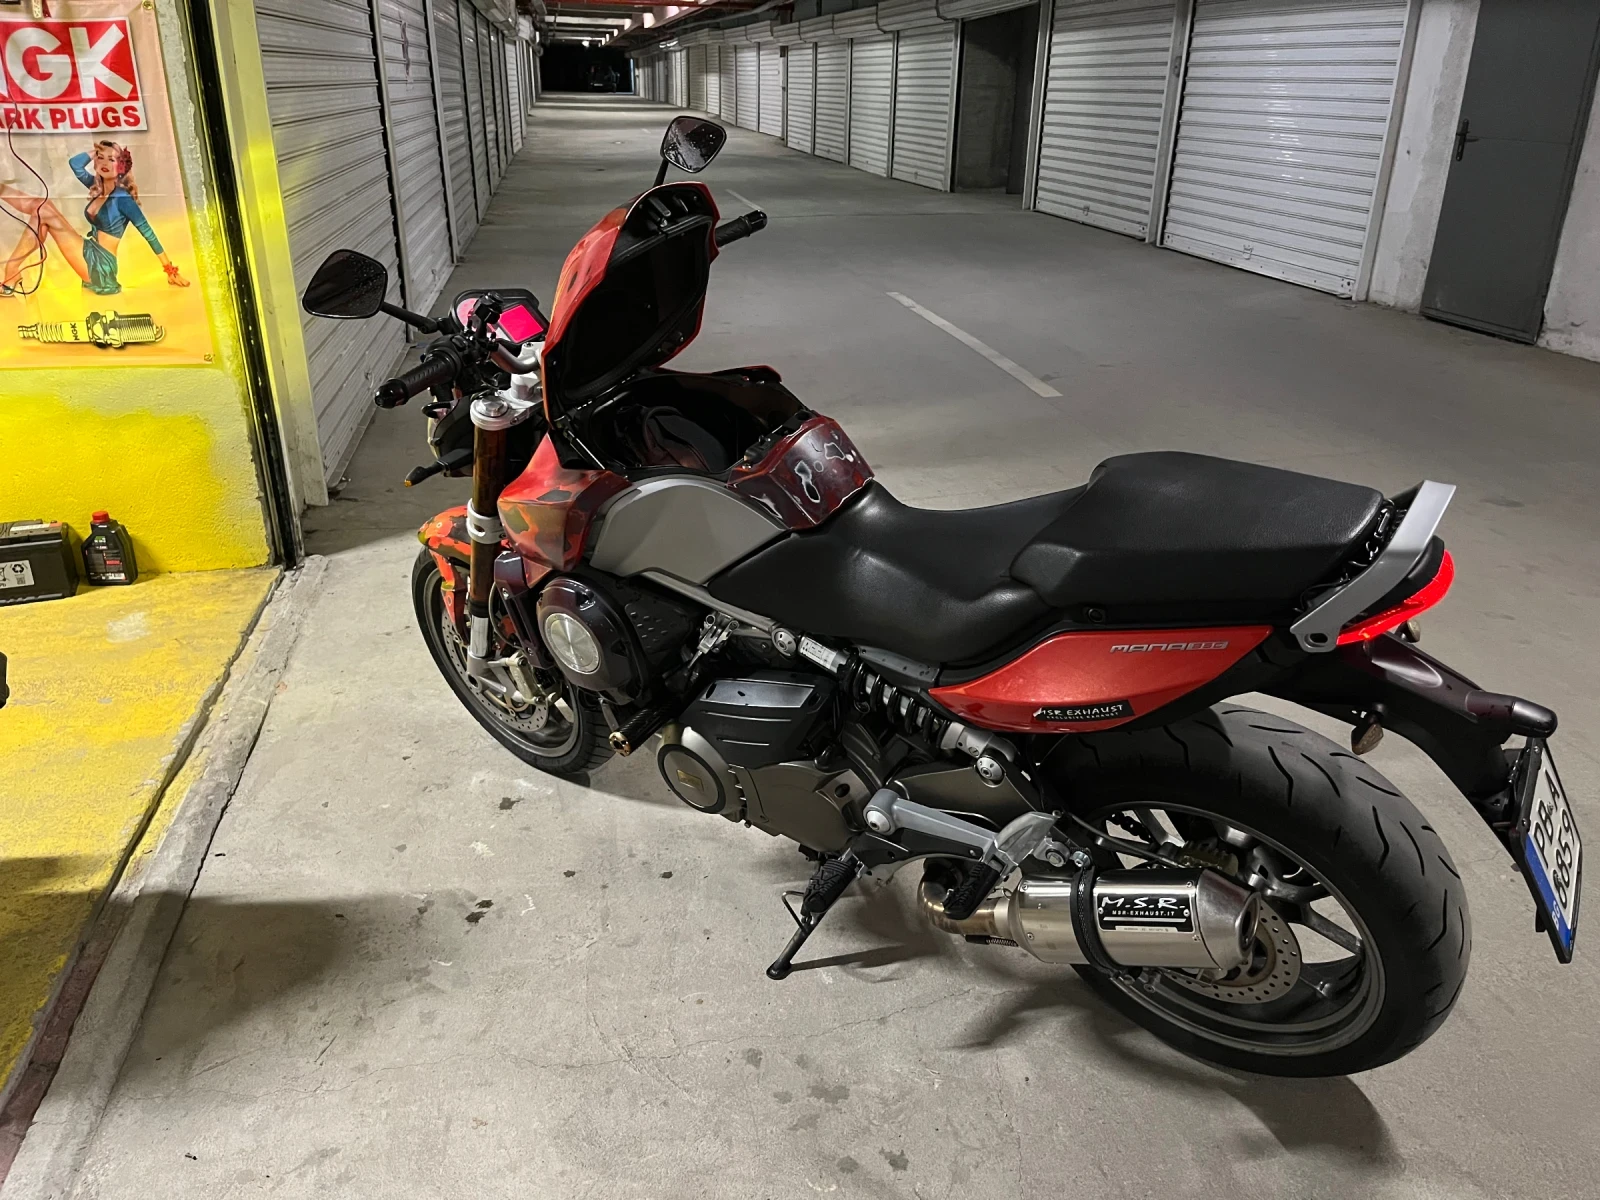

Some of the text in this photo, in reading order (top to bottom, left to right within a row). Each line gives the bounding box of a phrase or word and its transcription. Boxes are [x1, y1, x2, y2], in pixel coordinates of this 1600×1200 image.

[0, 23, 134, 99] GK
[49, 105, 141, 130] PLUGS
[70, 322, 80, 341] NGK
[1109, 642, 1187, 653] MANA
[1066, 704, 1123, 716] EXHAUST
[1533, 769, 1560, 870] PB A
[1101, 896, 1186, 910] M.S.R.
[1552, 900, 1561, 931] BG
